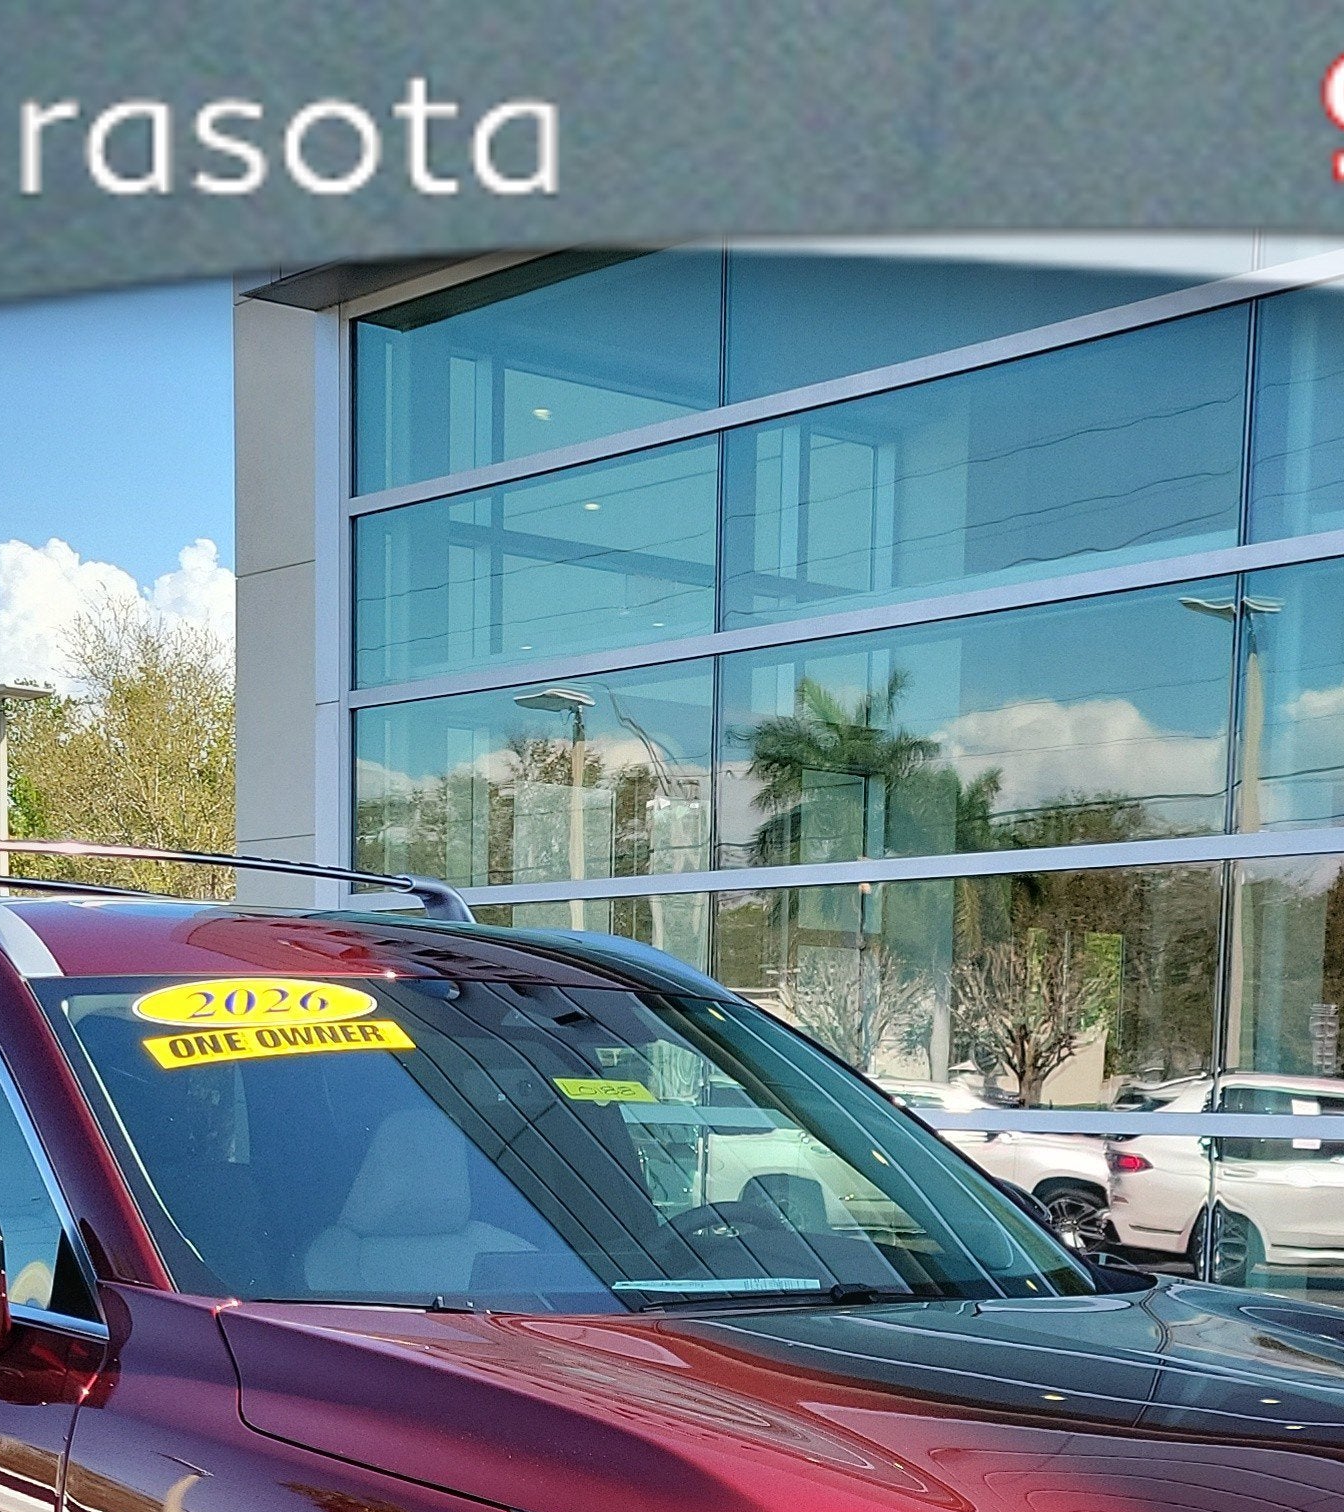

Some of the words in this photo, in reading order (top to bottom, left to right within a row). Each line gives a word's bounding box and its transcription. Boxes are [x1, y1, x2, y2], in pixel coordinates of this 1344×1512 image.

[185, 987, 330, 1020] 2026
[168, 1029, 247, 1060] ONE
[254, 1023, 385, 1050] OWNER
